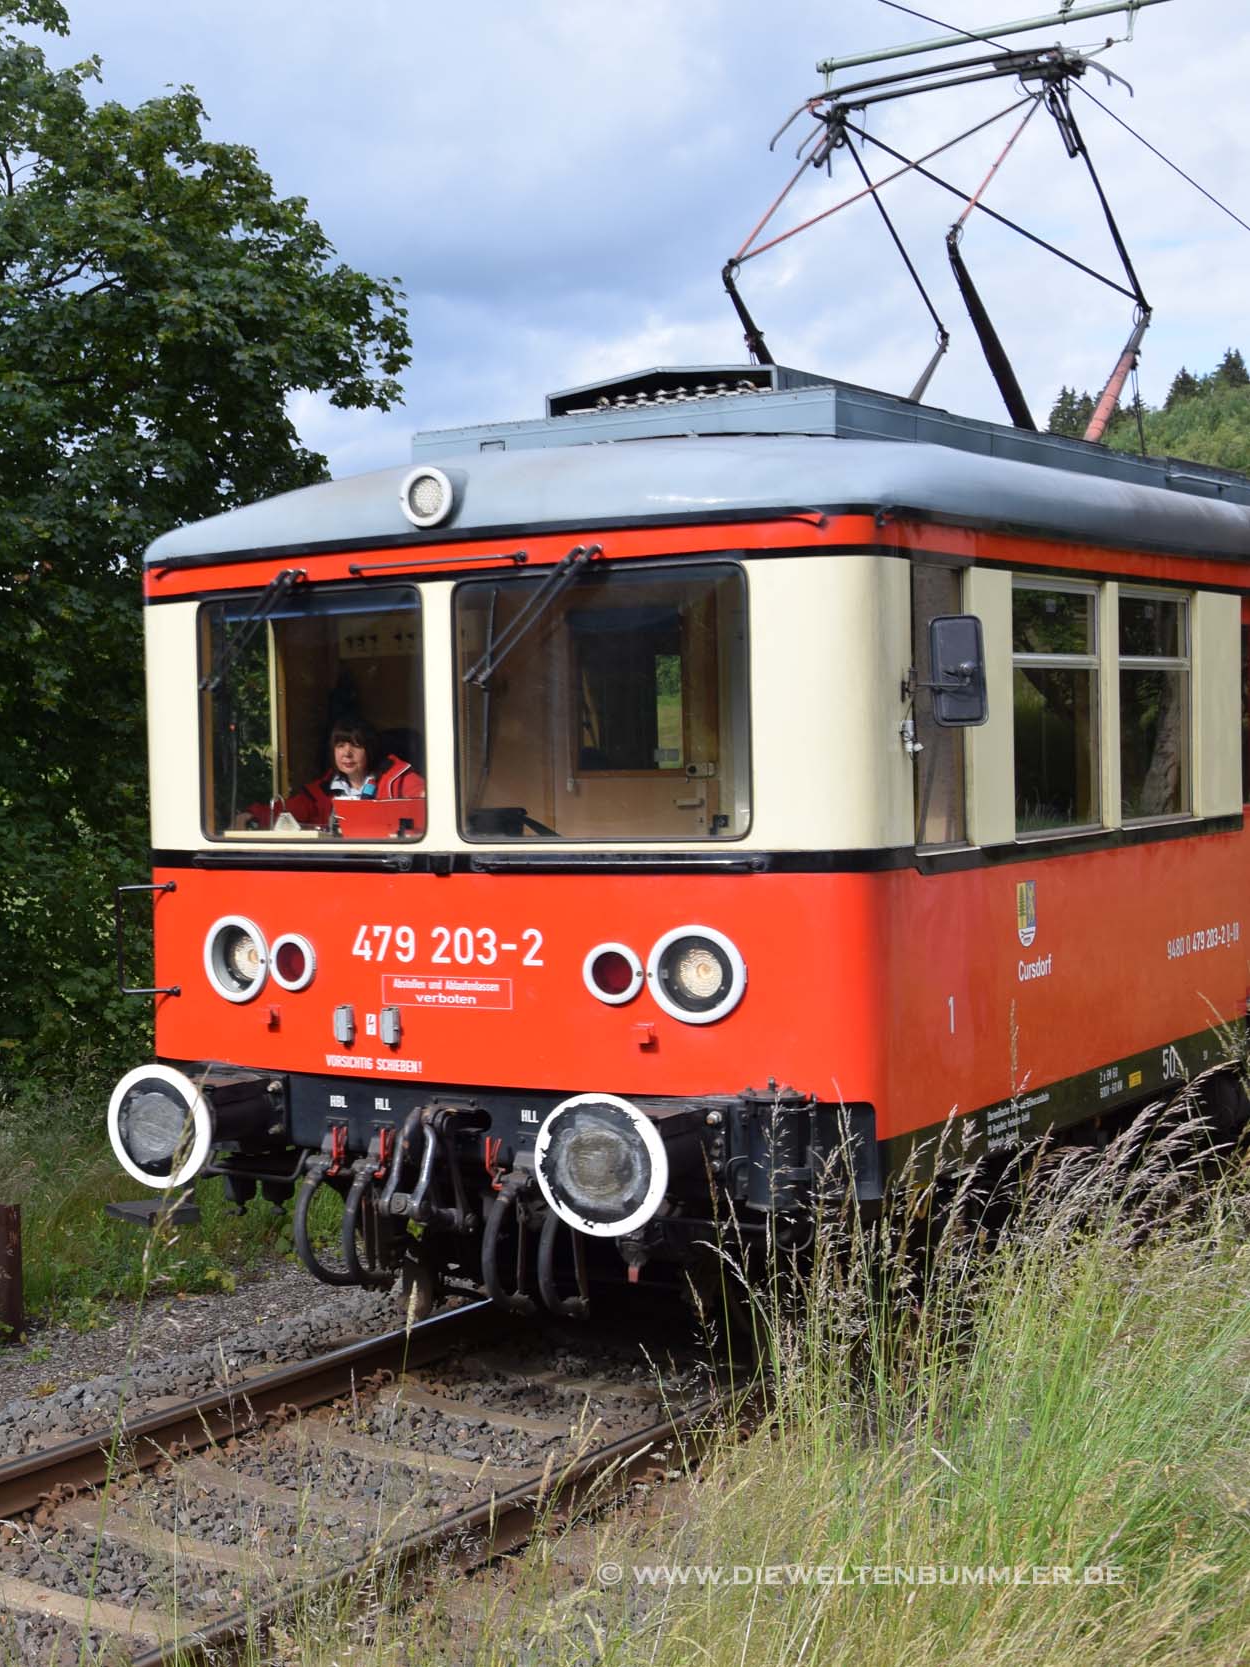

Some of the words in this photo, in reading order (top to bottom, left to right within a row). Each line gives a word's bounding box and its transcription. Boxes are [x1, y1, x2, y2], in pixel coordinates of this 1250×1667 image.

[351, 925, 416, 963] 479
[430, 926, 544, 967] 203-2
[1192, 930, 1205, 953] 479
[1017, 953, 1053, 983] Cursdorf
[428, 979, 443, 990] und
[415, 992, 478, 1005] verboten
[948, 995, 956, 1035] 1
[325, 1054, 374, 1071] VORSICHTIG
[374, 1097, 392, 1111] HLL
[520, 1109, 540, 1124] HLL
